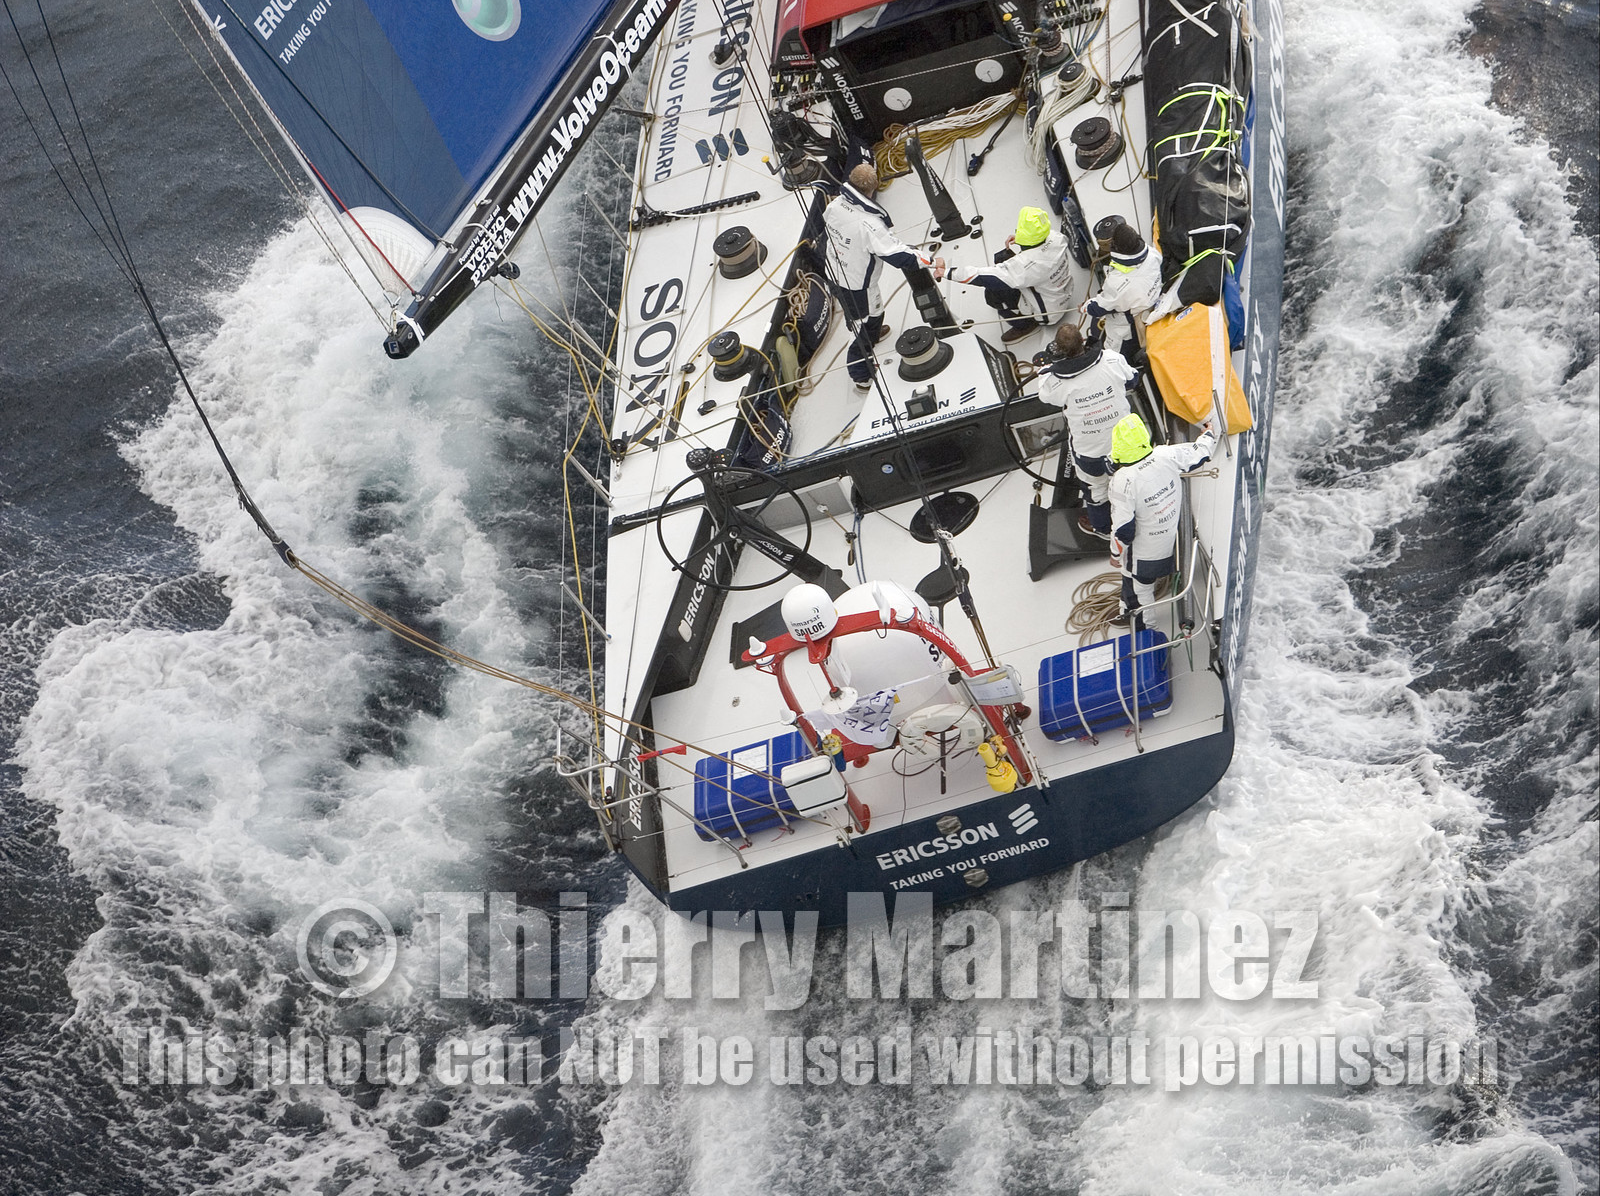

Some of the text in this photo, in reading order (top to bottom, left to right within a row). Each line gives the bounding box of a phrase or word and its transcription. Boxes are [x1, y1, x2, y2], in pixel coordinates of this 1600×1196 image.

[279, 23, 312, 65] TAKING
[306, 1, 327, 27] YOU
[668, 51, 690, 92] YOU
[833, 72, 864, 121] ERICSSON
[654, 93, 684, 182] FORWARD
[621, 277, 684, 453] SONY
[871, 399, 950, 430] ERICN
[1075, 391, 1105, 404] ERICSSON
[1138, 457, 1156, 471] SONY
[1144, 486, 1169, 504] ERICSSON
[794, 621, 825, 637] SAILOR
[875, 822, 1000, 871] ERICSSON
[889, 837, 1050, 890] TAKING YOU FORWARD
